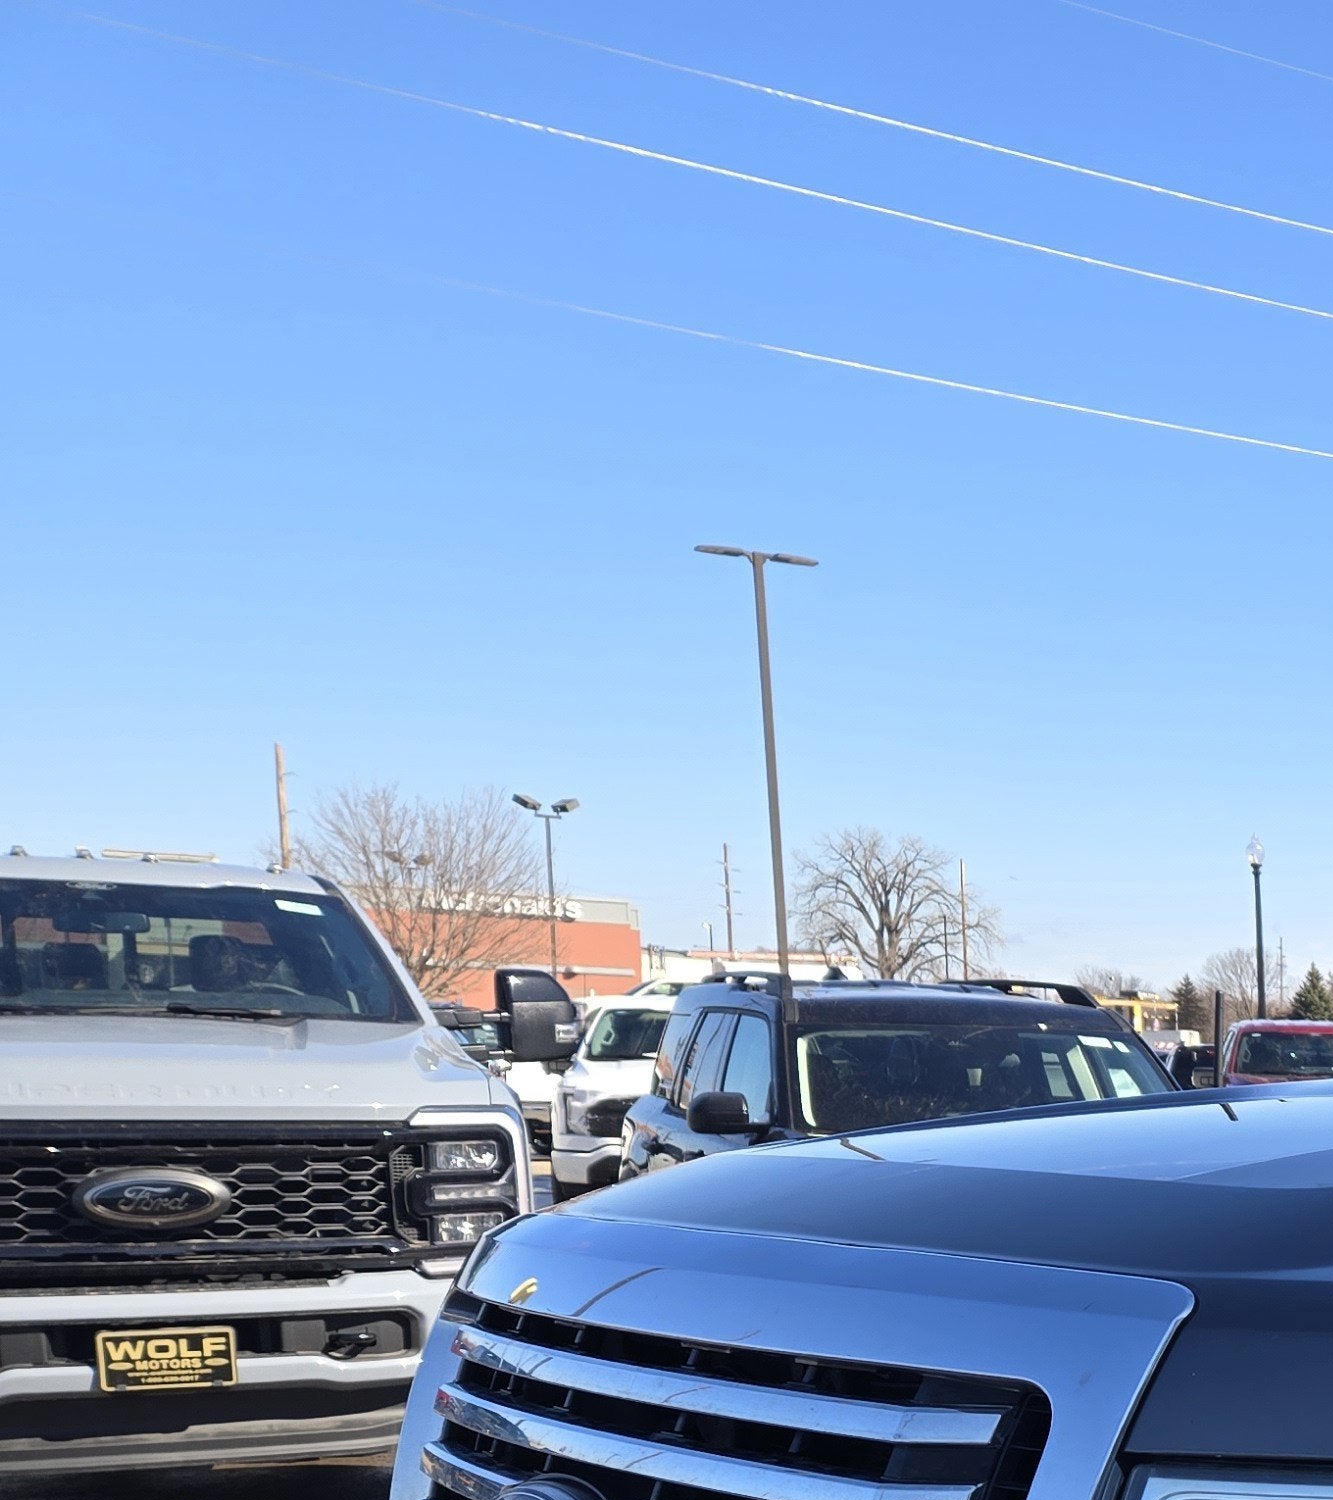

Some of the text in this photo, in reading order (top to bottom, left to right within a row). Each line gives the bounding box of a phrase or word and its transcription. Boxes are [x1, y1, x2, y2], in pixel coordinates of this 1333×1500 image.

[118, 1186, 189, 1211] Ford
[105, 1336, 227, 1361] WOLF
[134, 1358, 202, 1371] MOTORS
